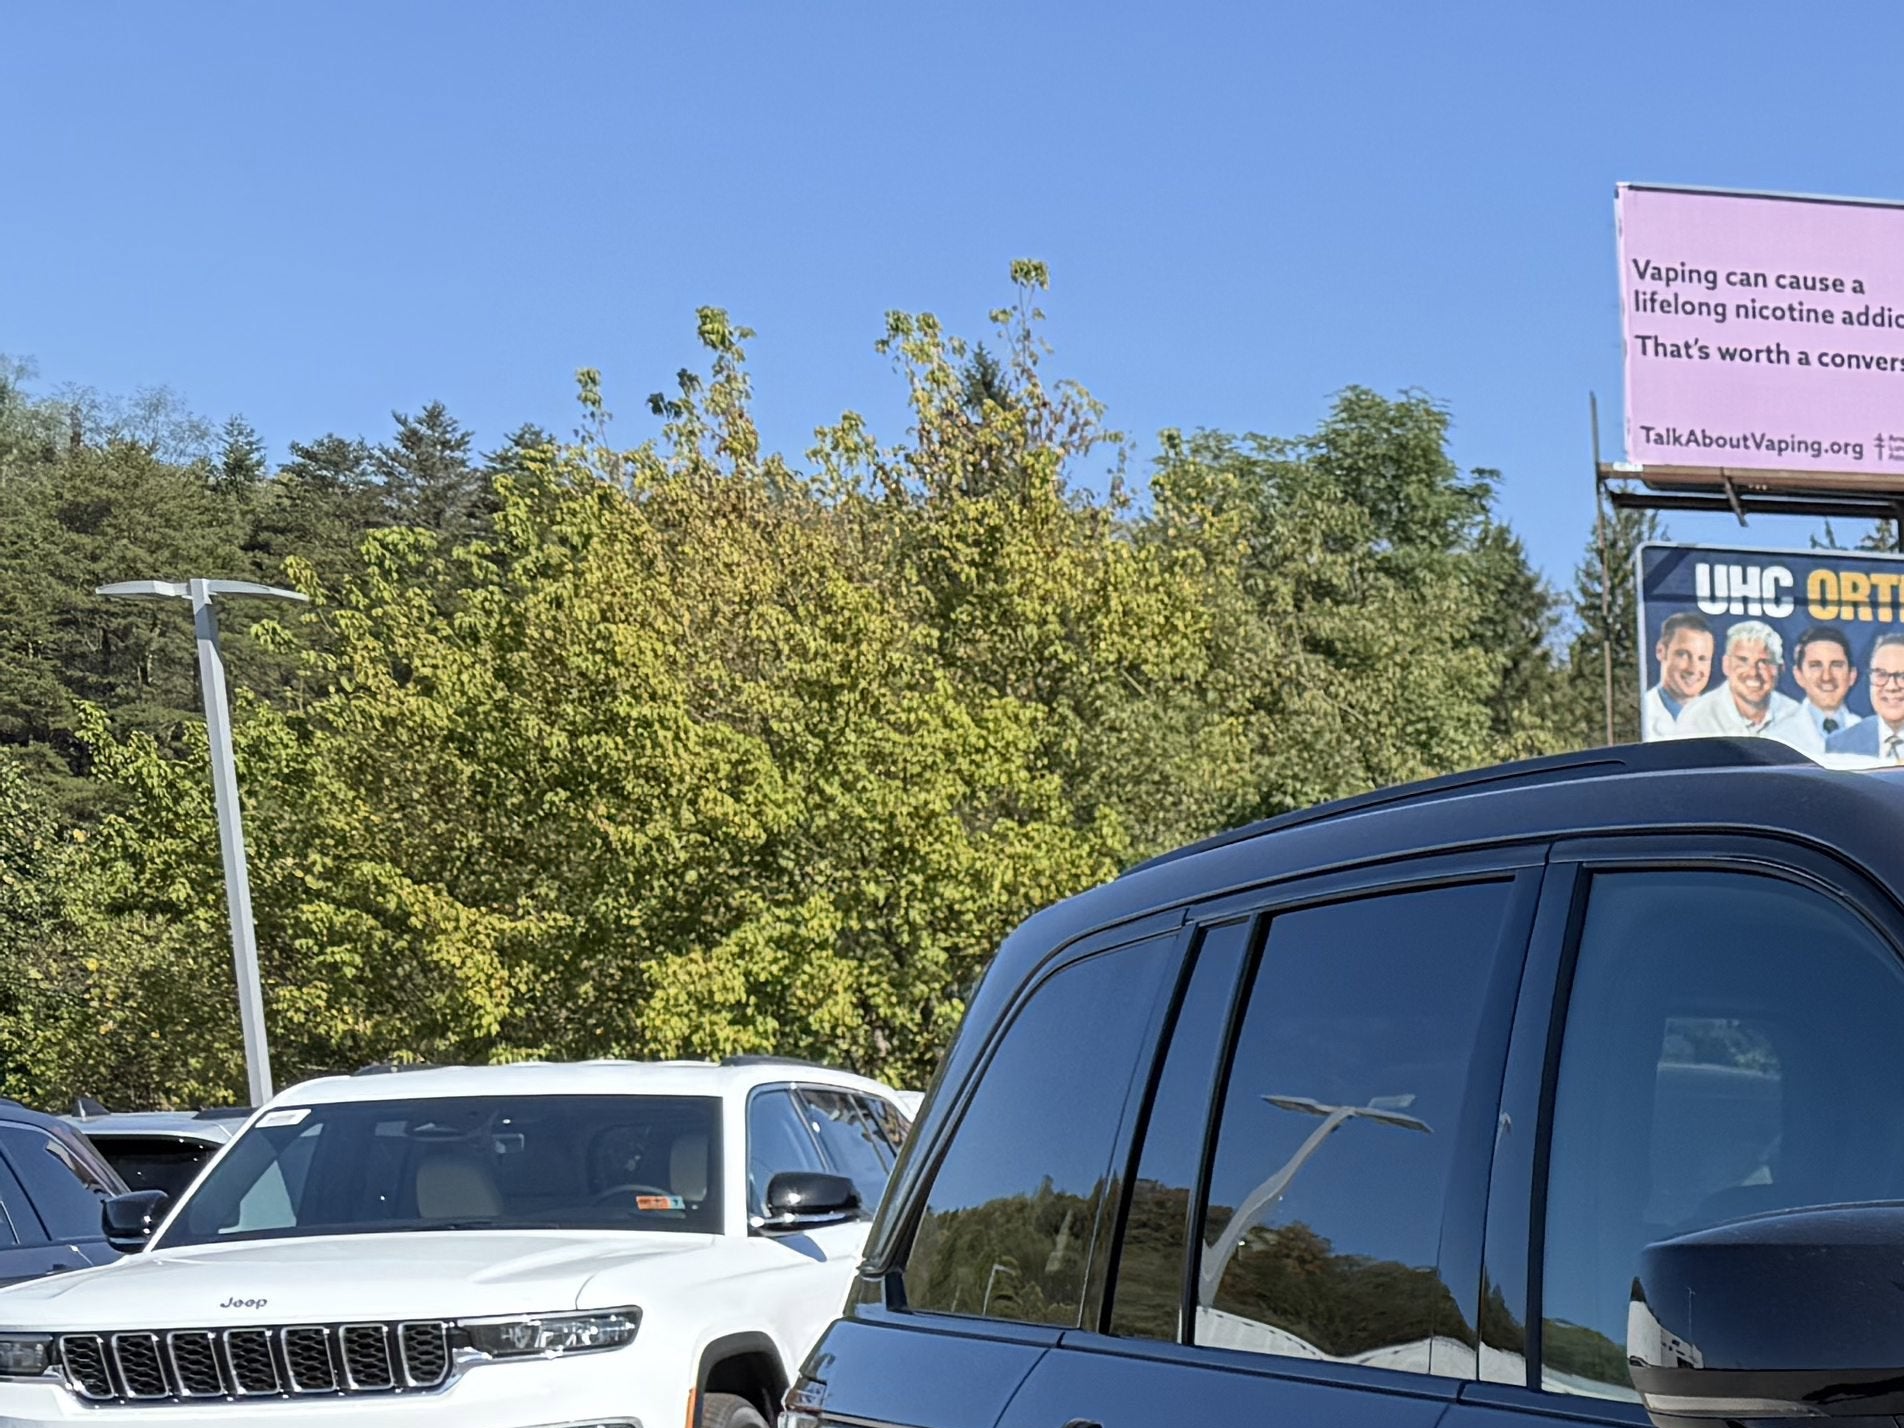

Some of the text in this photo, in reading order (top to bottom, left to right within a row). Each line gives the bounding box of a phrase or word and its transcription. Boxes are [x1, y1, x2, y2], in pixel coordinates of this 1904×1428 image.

[1632, 258, 1865, 295] Vaping can cause a
[1634, 289, 1727, 323] lifelong
[1735, 298, 1834, 325] nicotine
[1634, 334, 1710, 361] That's
[1717, 342, 1790, 366] worth
[1797, 350, 1811, 367] a
[1639, 425, 1865, 461] TalkAboutVaping.org
[1695, 563, 1794, 618] UHC
[219, 1296, 268, 1310] Jeep
